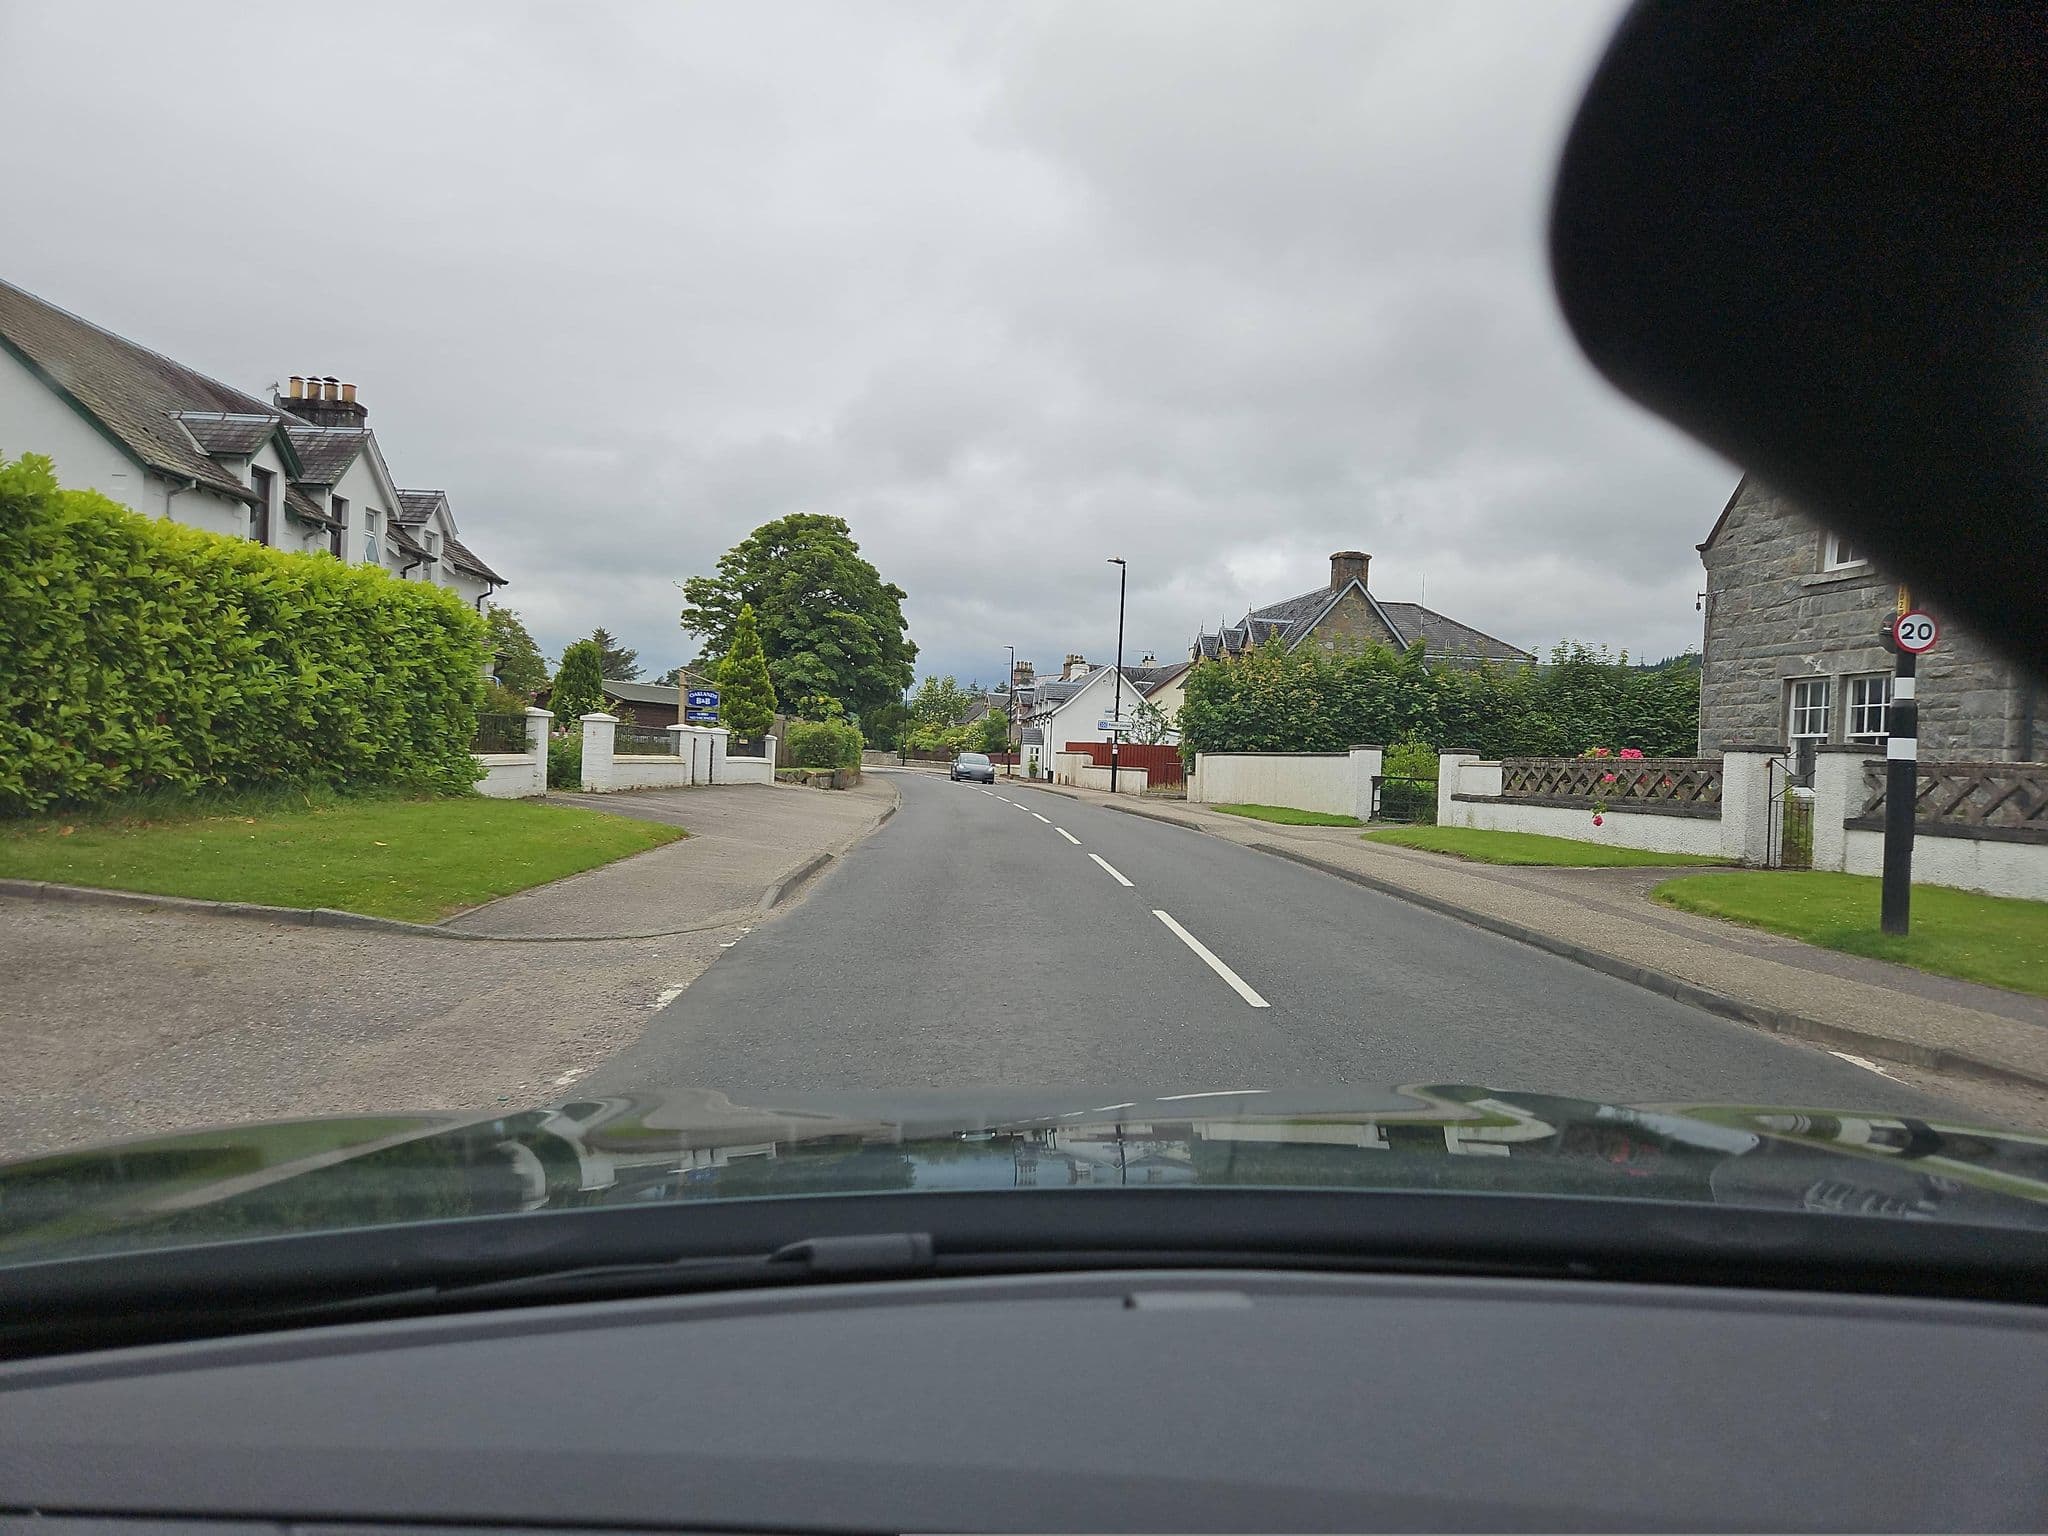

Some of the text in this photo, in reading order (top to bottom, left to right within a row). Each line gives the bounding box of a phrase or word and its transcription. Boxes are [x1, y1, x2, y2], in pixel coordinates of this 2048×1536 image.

[1901, 623, 1933, 640] 20
[689, 691, 718, 699] OAKLANDS
[696, 697, 711, 705] B&B
